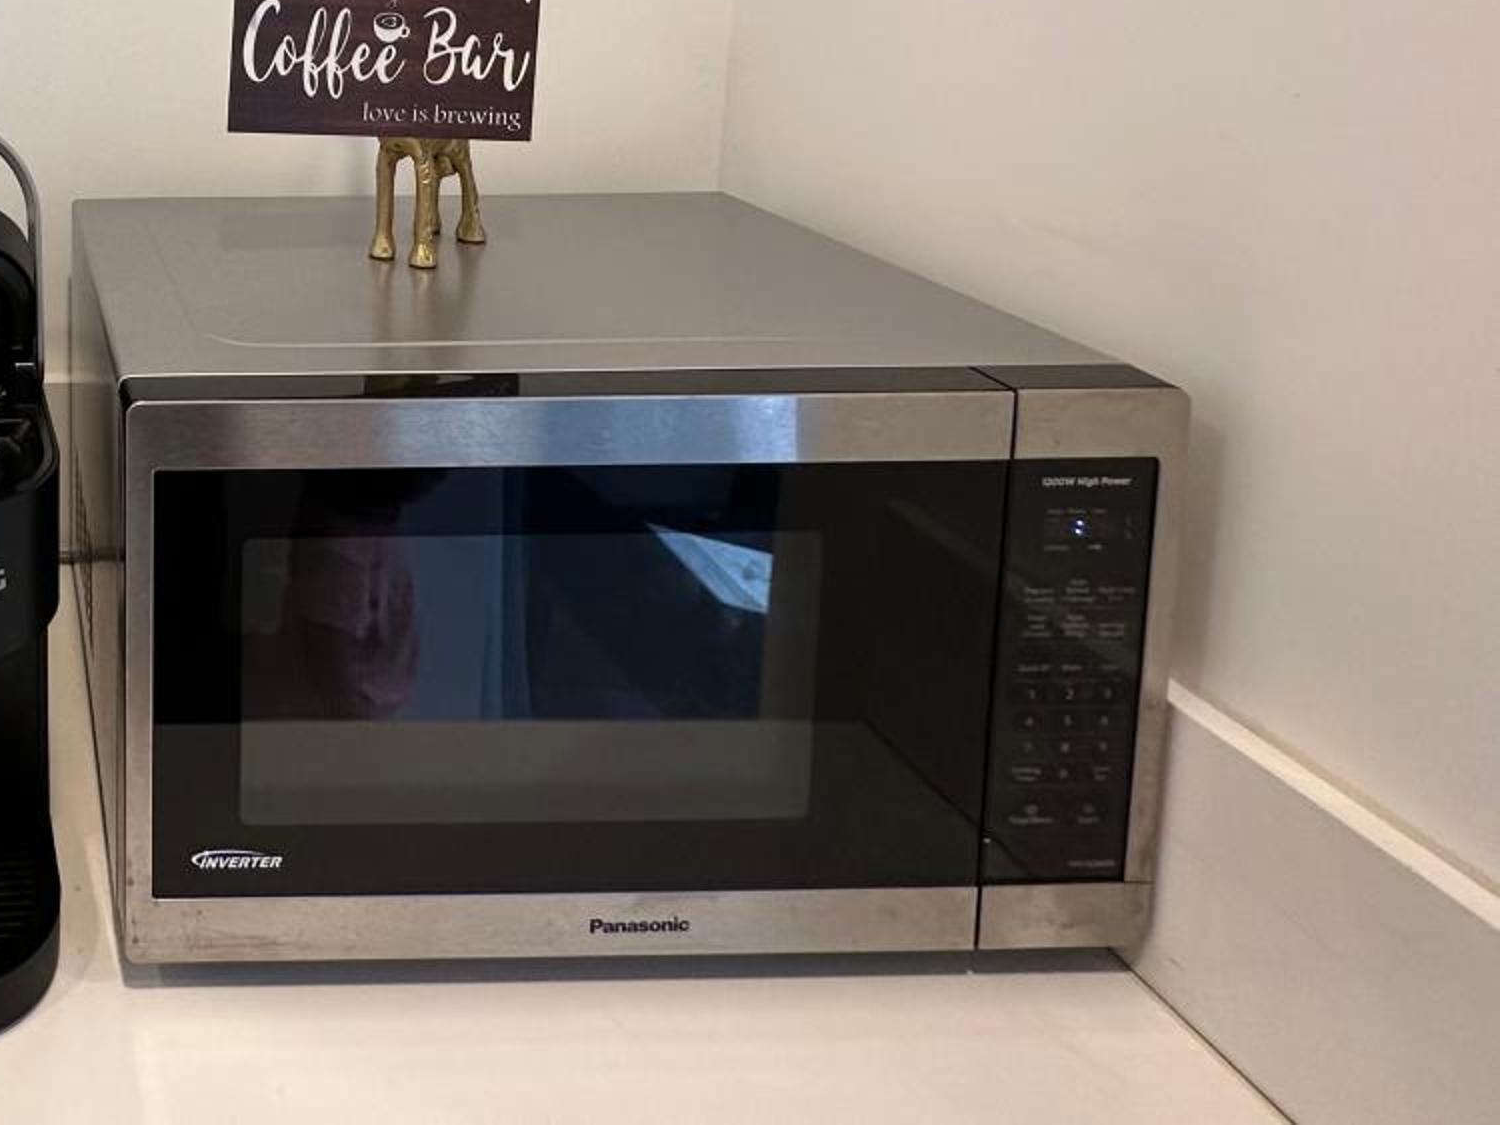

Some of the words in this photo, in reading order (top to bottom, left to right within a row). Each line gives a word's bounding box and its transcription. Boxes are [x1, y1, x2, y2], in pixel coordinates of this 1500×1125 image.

[423, 6, 531, 92] Bar
[362, 101, 407, 122] love
[411, 103, 430, 123] is
[433, 104, 522, 131] brewing
[198, 855, 283, 869] INVERTER
[589, 916, 690, 934] Panasonic
